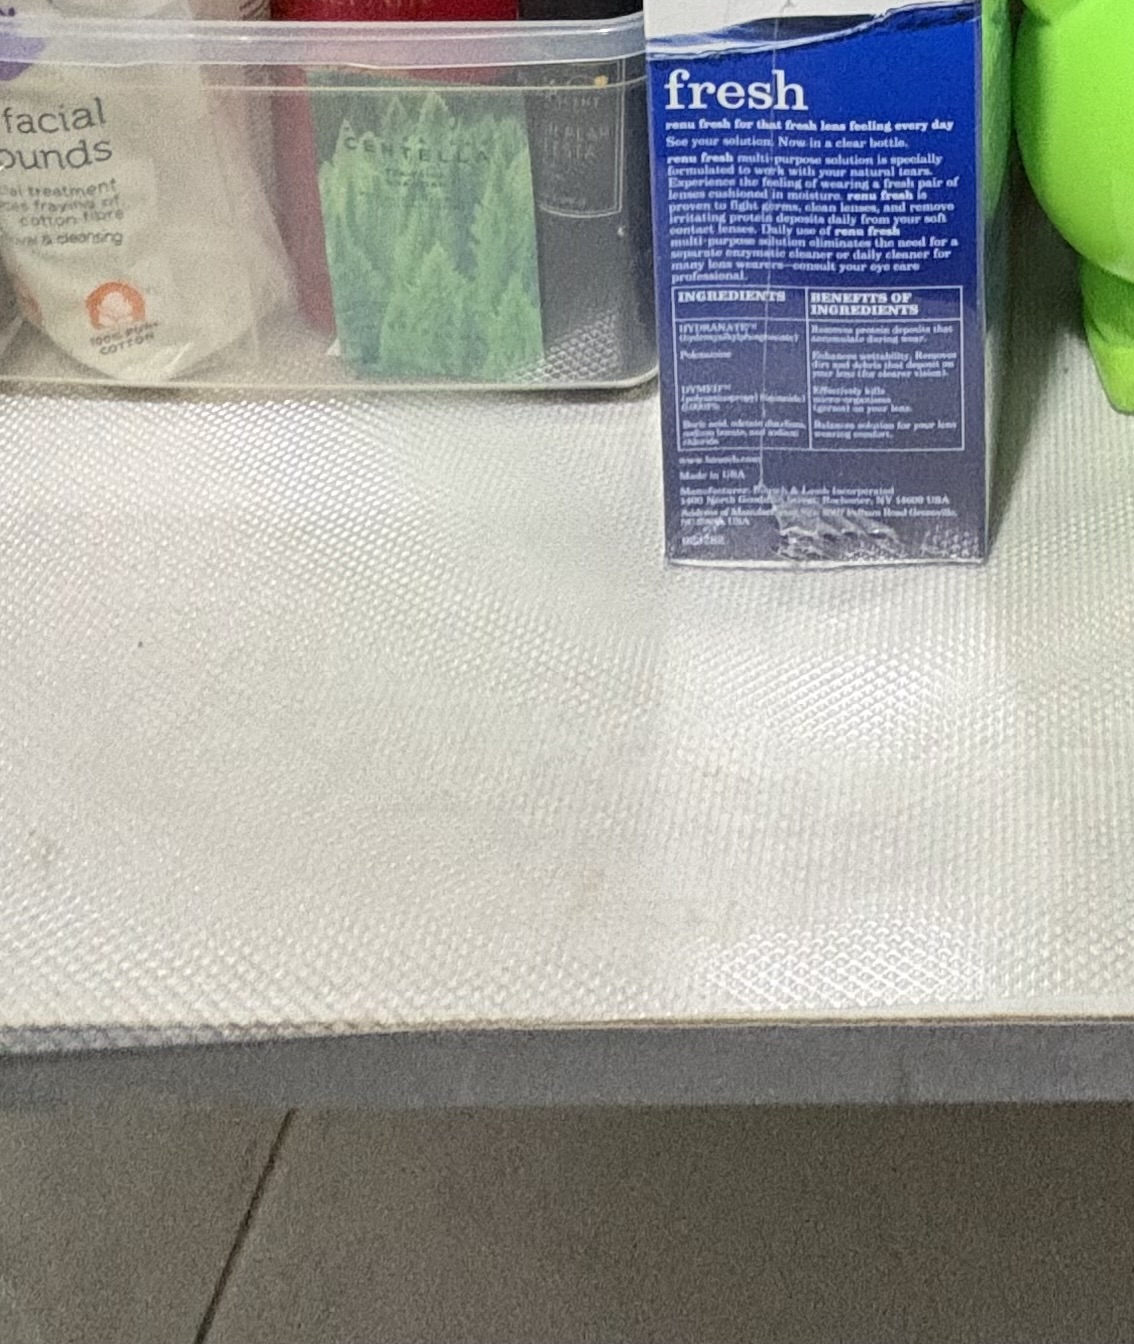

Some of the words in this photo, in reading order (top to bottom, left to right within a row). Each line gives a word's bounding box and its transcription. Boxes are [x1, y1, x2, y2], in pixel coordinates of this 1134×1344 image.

[665, 69, 809, 112] fresh
[3, 97, 107, 134] facial
[665, 121, 696, 131] renu
[698, 118, 731, 130] fresh
[734, 118, 754, 130] for
[756, 119, 782, 130] that
[785, 119, 817, 131] fresh
[820, 119, 846, 131] lens
[849, 120, 893, 133] feeling
[894, 121, 928, 132] every
[931, 118, 954, 131] day
[343, 135, 490, 163] CENTELLA
[666, 135, 689, 147] See
[691, 137, 719, 149] your
[777, 135, 806, 148] Now
[809, 136, 821, 148] in
[824, 138, 833, 148] a
[835, 137, 867, 148] clear
[869, 136, 908, 149] bottle.
[667, 155, 697, 165] renu
[700, 151, 734, 163] fresh
[737, 152, 822, 166] multi-purpose
[825, 153, 874, 165] solution
[877, 153, 888, 165] is
[890, 152, 943, 167] specially
[667, 164, 735, 177] formulated
[738, 165, 751, 175] to
[754, 165, 785, 177] work
[788, 166, 816, 177] with
[818, 168, 847, 179] your
[850, 166, 895, 178] natural
[898, 167, 933, 177] tears.
[28, 178, 117, 198] treatment
[668, 176, 736, 189] Experience
[739, 176, 759, 187] the
[762, 176, 803, 189] feeling
[804, 178, 818, 189] of
[820, 179, 870, 191] wearing
[872, 180, 880, 189] a
[883, 177, 915, 189] fresh
[917, 177, 943, 190] pair
[945, 175, 960, 188] of
[668, 189, 706, 201] lenses
[708, 187, 769, 199] cushioned
[772, 189, 784, 200] in
[847, 191, 877, 201] renu
[880, 189, 914, 201] fresh
[917, 189, 928, 200] is
[669, 202, 711, 214] proven
[714, 200, 727, 211] to
[730, 199, 759, 213] fight
[804, 201, 837, 213] clean
[882, 200, 906, 213] and
[909, 201, 956, 212] remove
[19, 214, 78, 228] cotton
[83, 209, 125, 223] fibre
[669, 211, 727, 224] irritating
[729, 212, 773, 224] protein
[776, 212, 825, 225] deposits
[827, 213, 857, 227] daily
[860, 213, 891, 225] from
[893, 215, 921, 228] your
[924, 211, 948, 224] soft
[669, 224, 714, 236] contact
[761, 223, 793, 236] Daily
[795, 226, 816, 236] use
[819, 225, 832, 236] of
[834, 226, 865, 237] renu
[867, 224, 900, 237] fresh
[56, 232, 124, 247] cleansing
[670, 236, 756, 248] multi-purpose
[758, 236, 806, 248] solution
[808, 237, 872, 249] eliminates
[874, 237, 894, 248] the
[897, 236, 926, 248] need
[929, 235, 948, 247] for
[950, 238, 959, 247] a
[671, 260, 705, 272] many
[707, 258, 733, 270] lens
[839, 262, 867, 274] your
[869, 262, 890, 274] eye
[893, 263, 921, 272] care
[671, 270, 749, 285] professional.
[677, 290, 786, 303] INGREDIENTS
[810, 292, 888, 304] BENEFITS
[890, 291, 913, 304] OF
[810, 304, 919, 316] INGREDIENTS
